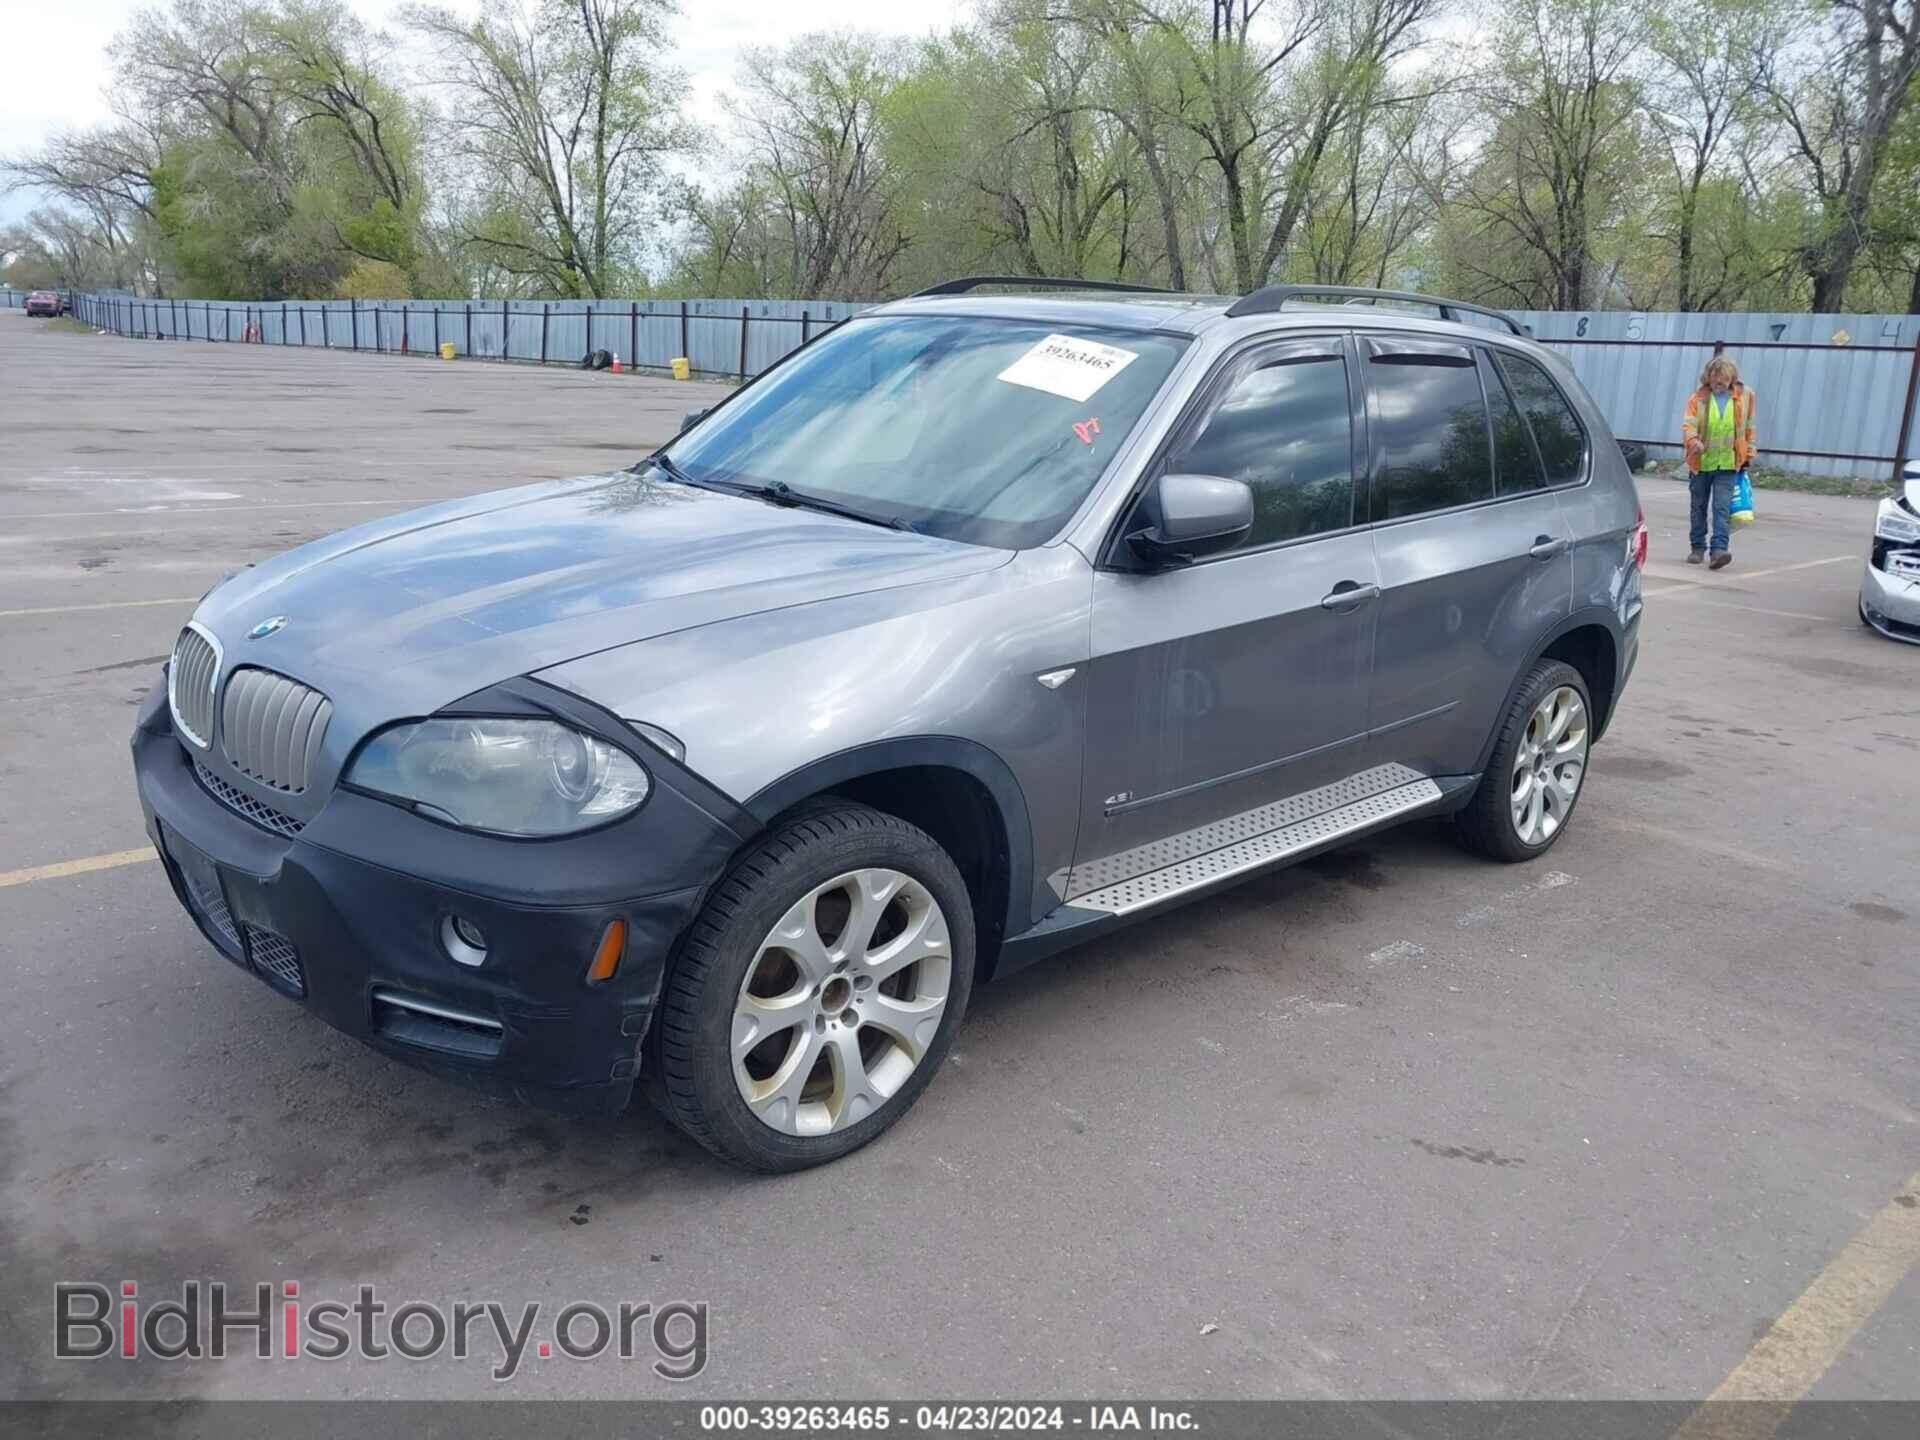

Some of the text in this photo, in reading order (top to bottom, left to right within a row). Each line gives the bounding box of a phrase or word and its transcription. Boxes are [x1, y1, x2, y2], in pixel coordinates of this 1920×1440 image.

[1576, 316, 1589, 338] 8
[1627, 317, 1647, 341] 5
[1770, 323, 1787, 342] 7
